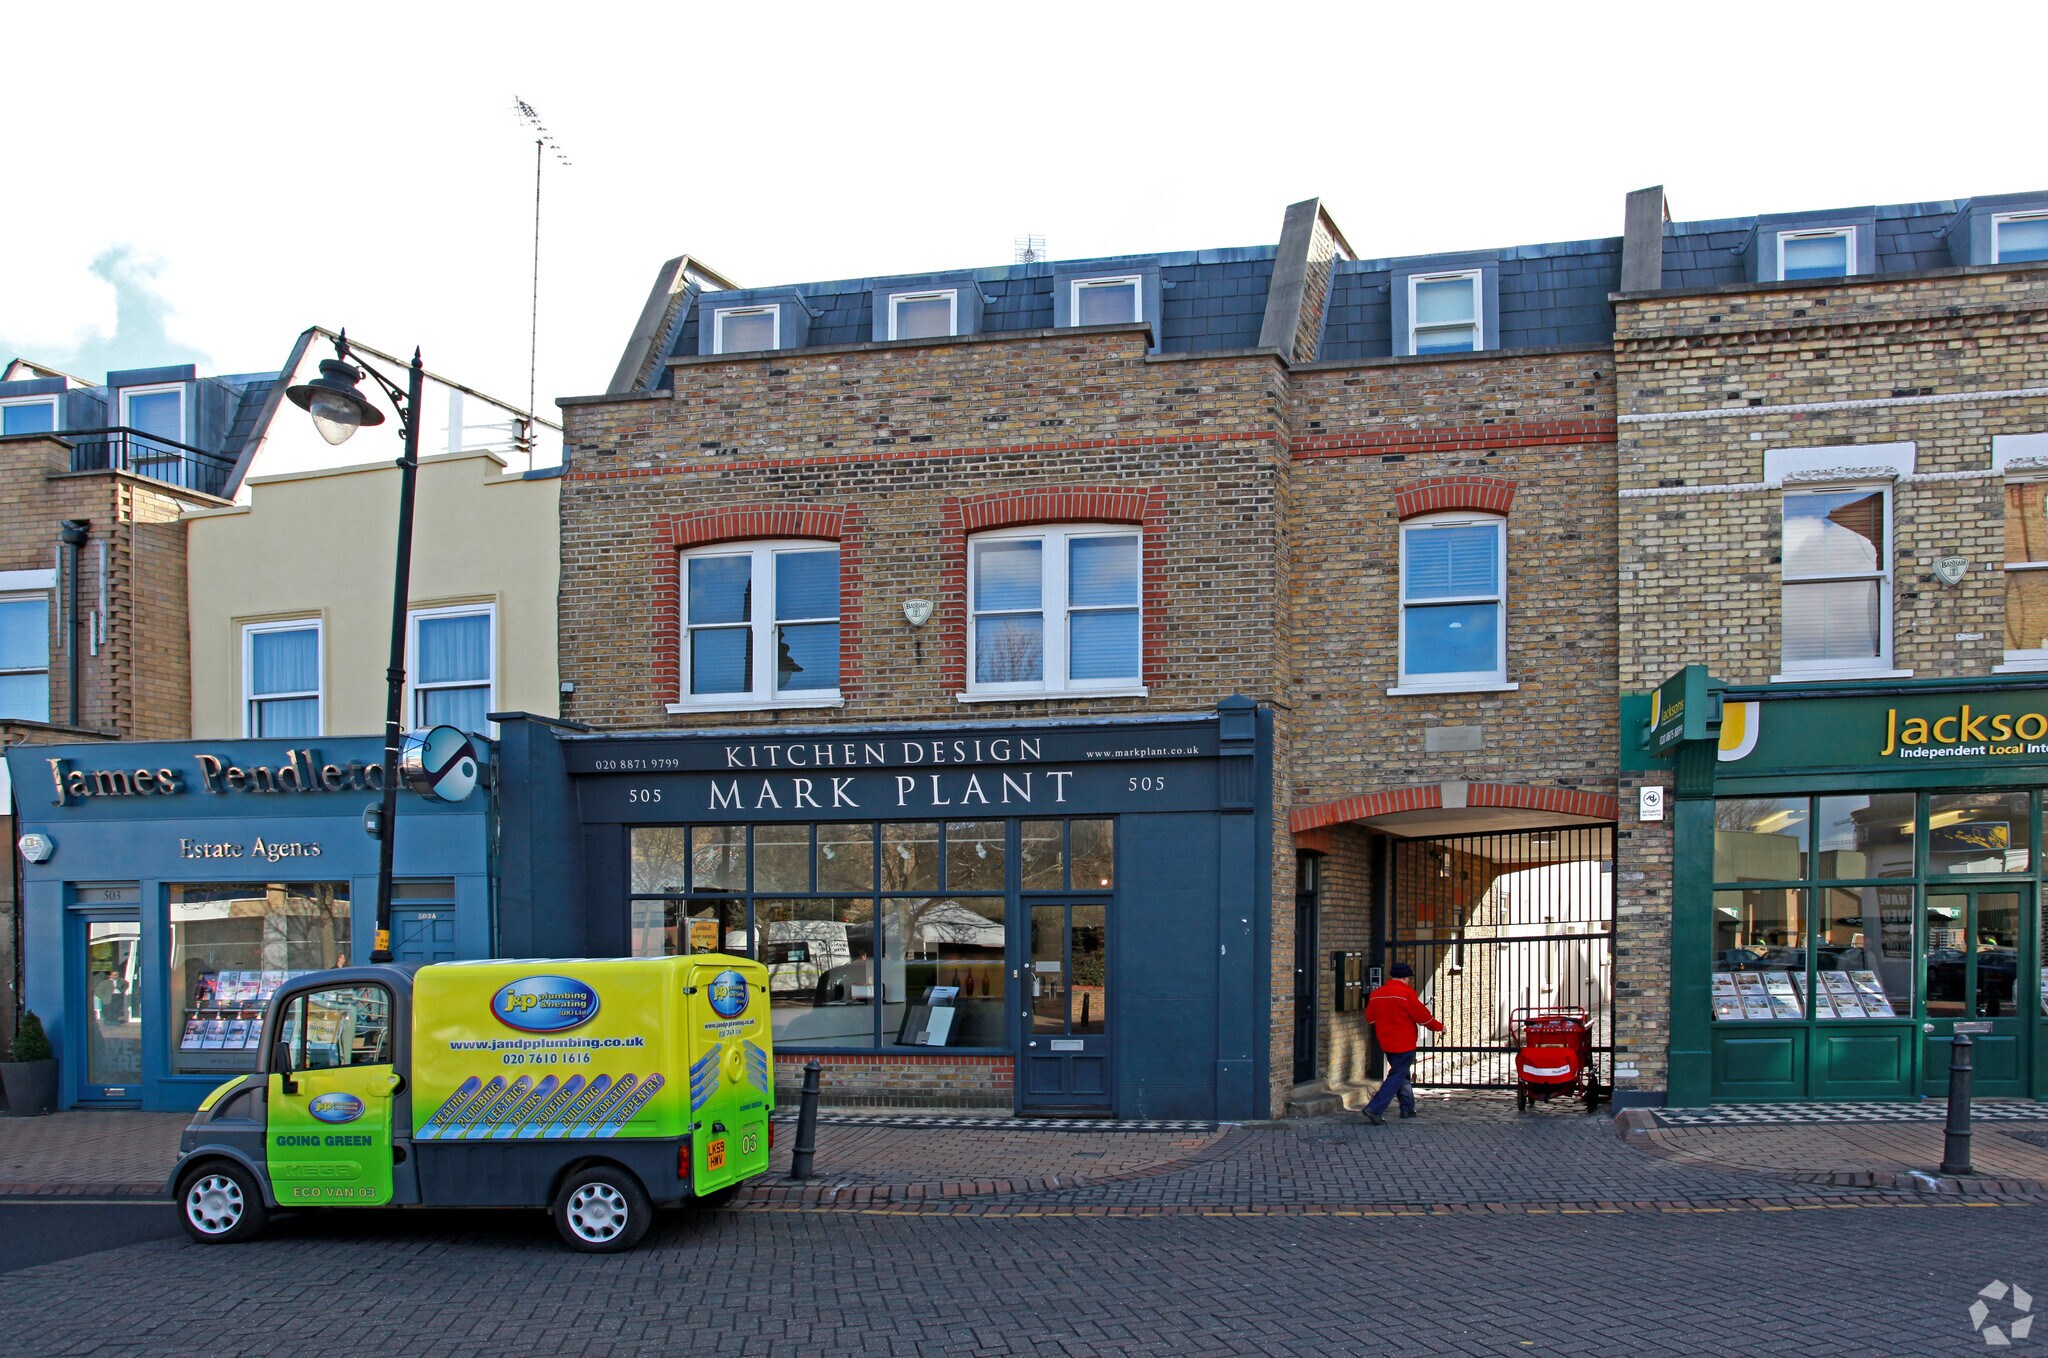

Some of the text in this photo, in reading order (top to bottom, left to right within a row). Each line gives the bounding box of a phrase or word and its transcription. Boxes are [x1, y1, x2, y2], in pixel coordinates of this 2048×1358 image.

[1881, 704, 2048, 756] Jackso
[725, 738, 1041, 768] KITCHEN DESIGN
[1086, 745, 1199, 758] www.markplant.co.uk
[1900, 743, 2048, 759] Independent Local Int
[595, 758, 679, 770] 020 8871 9799
[46, 758, 180, 807] James
[708, 771, 1073, 810] MARK PLANT
[1128, 777, 1165, 792] 505
[629, 789, 662, 803] 505
[180, 836, 323, 863] Estate Agents
[104, 890, 121, 901] 503
[504, 989, 538, 1012] j&p
[539, 992, 587, 1000] plumbing
[450, 1036, 644, 1051] www.jandpplumbing.co.uk
[503, 1052, 591, 1064] 020 7610 1616
[432, 1090, 468, 1126] HEATING
[458, 1081, 502, 1128] PLUMBING
[482, 1081, 529, 1127] ELECTRICS
[508, 1092, 544, 1127] DRAINS
[534, 1088, 572, 1128] ROOFING
[560, 1085, 601, 1128] BUILDING
[585, 1076, 635, 1128] DECORATING
[612, 1075, 663, 1127] CARPENTRY
[276, 1135, 372, 1146] GOING GREEN
[743, 1132, 757, 1154] 03
[293, 1187, 376, 1198] ECO VAN 03
